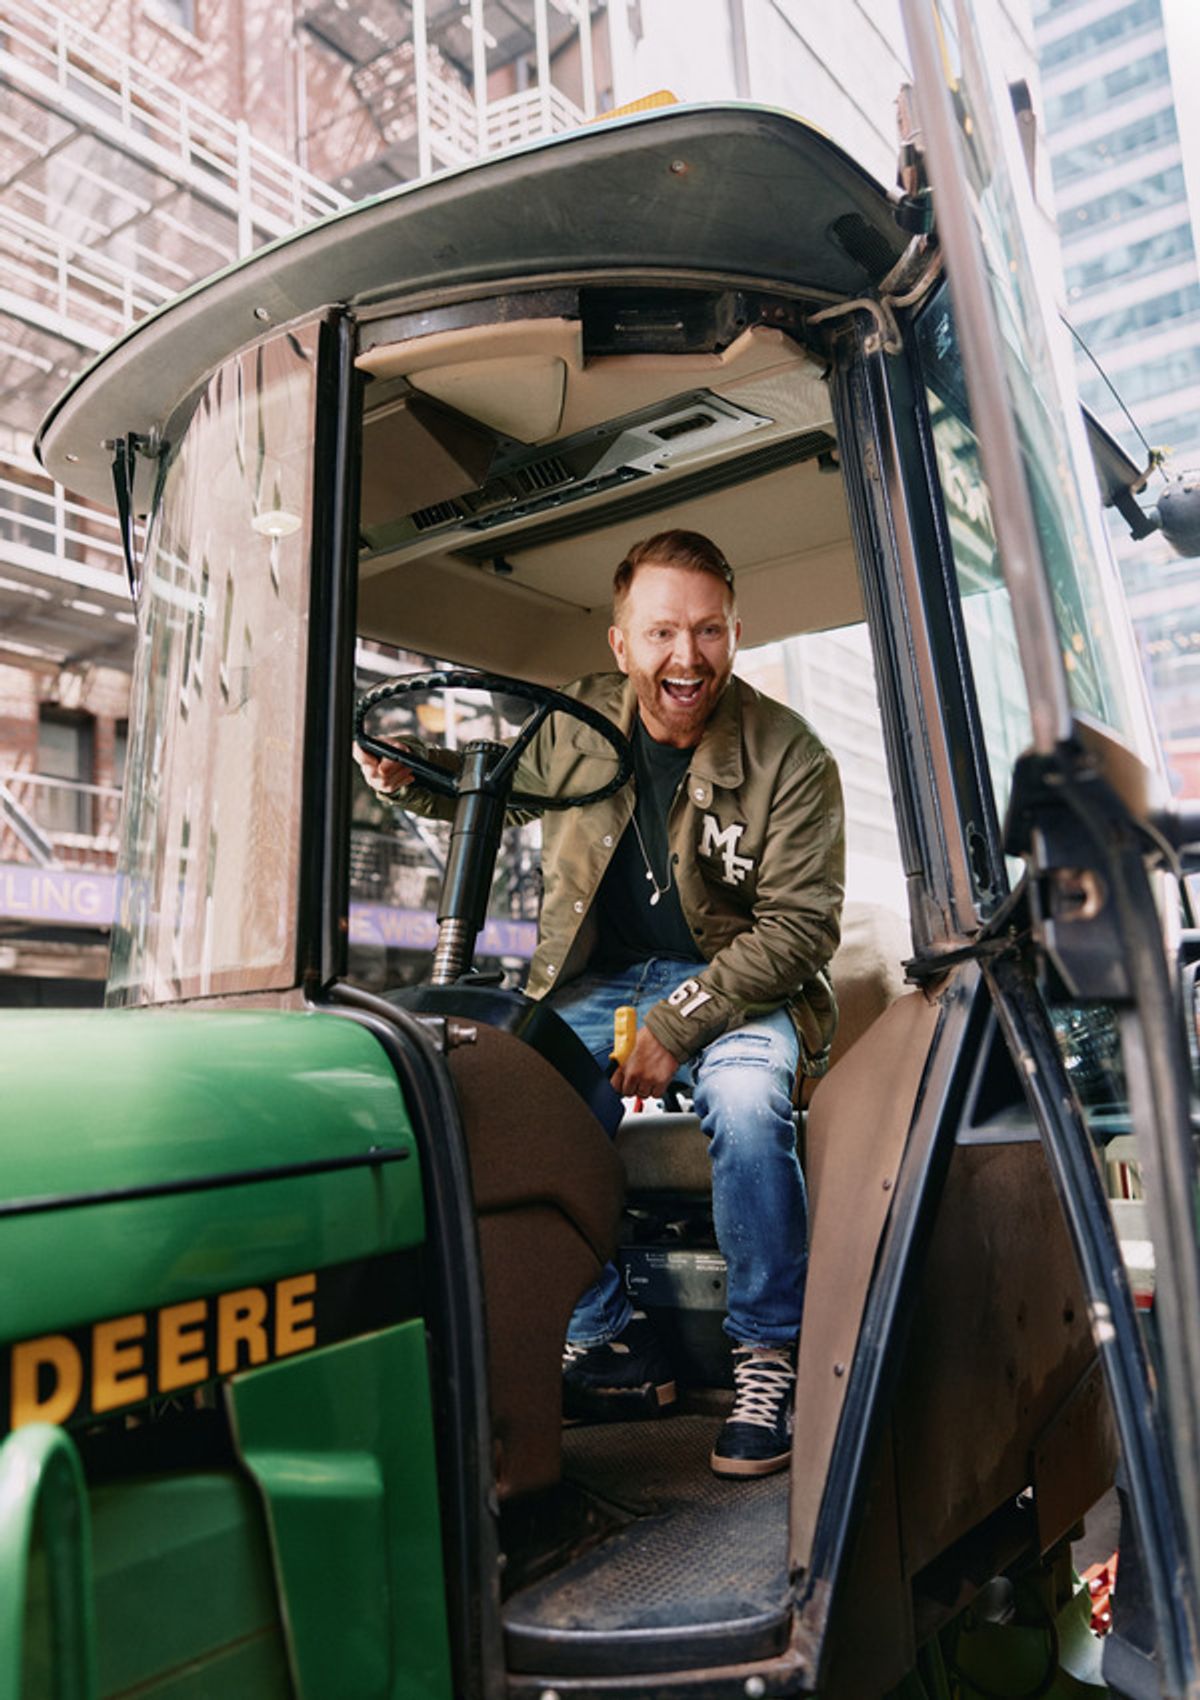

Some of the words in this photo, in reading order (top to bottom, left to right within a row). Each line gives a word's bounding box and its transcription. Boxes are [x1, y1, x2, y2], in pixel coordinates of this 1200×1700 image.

[699, 814, 754, 886] MF
[0, 872, 100, 916] LING
[378, 910, 437, 945] WIS
[668, 979, 711, 1018] 61
[10, 1272, 317, 1430] DEERE
